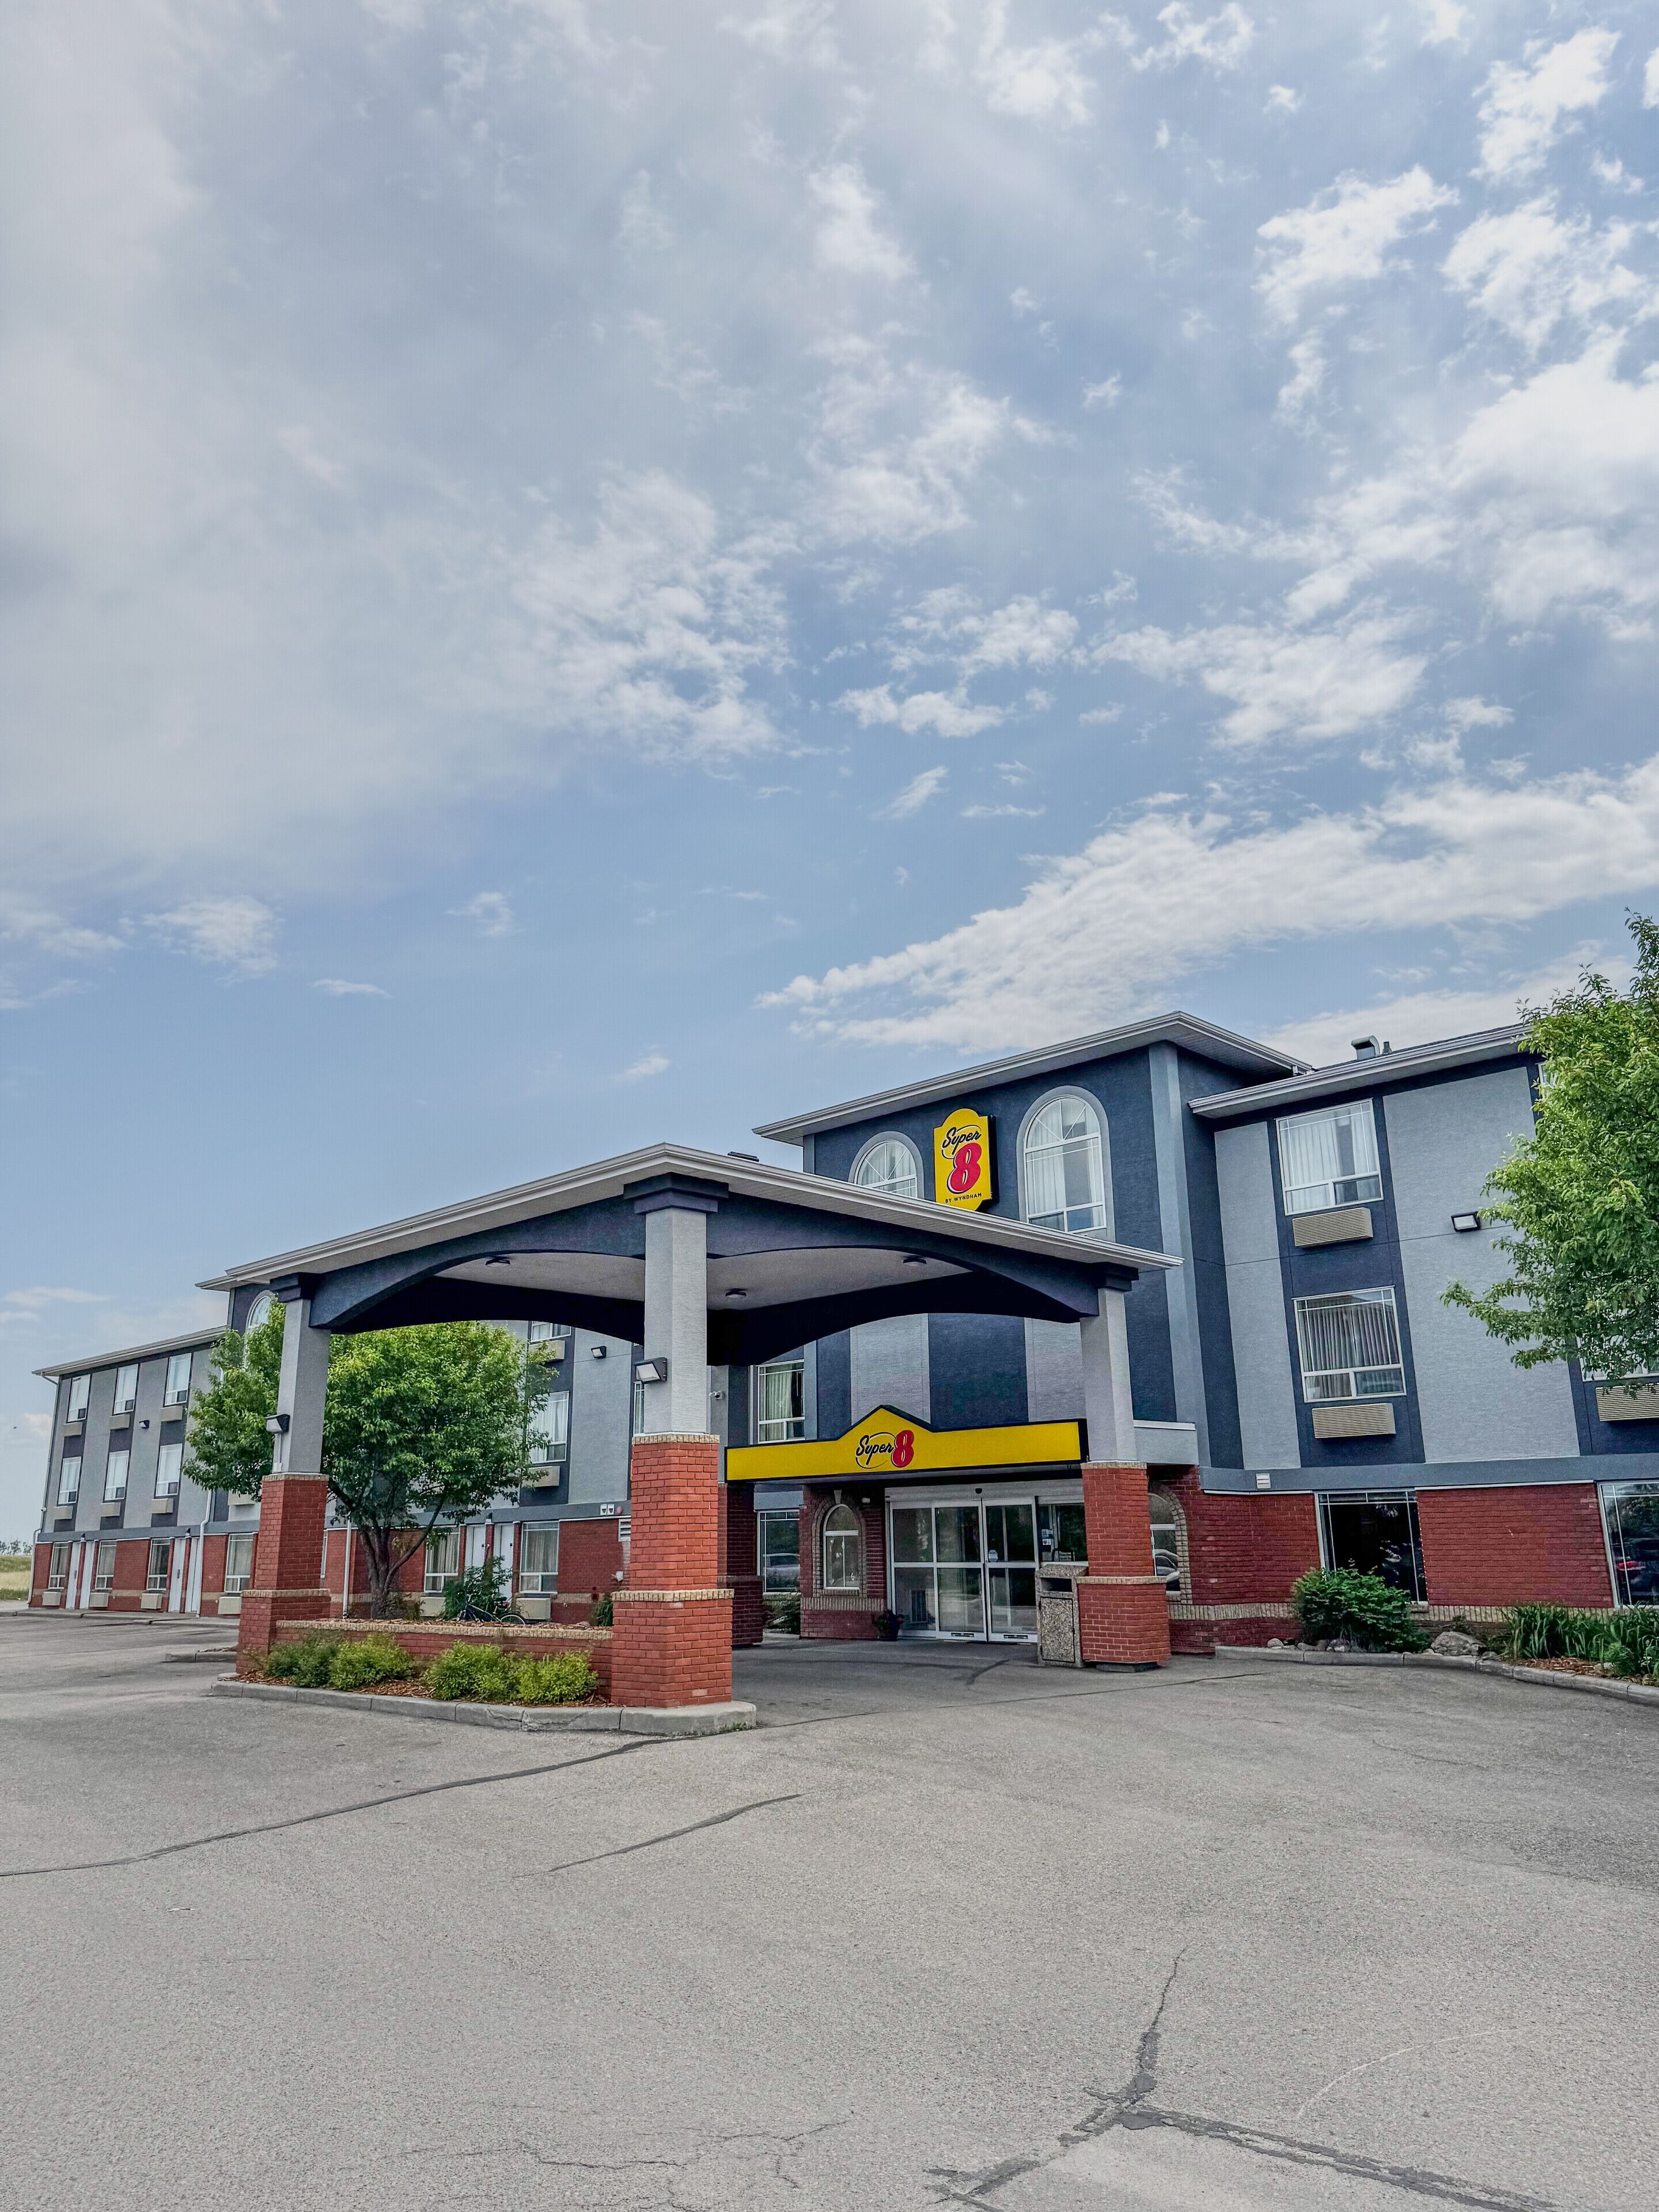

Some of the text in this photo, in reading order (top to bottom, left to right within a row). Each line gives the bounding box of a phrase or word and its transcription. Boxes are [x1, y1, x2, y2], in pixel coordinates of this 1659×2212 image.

[942, 1127, 982, 1155] Super
[946, 1142, 982, 1194] 8
[954, 1192, 982, 1202] WYNDHAM
[856, 1430, 914, 1468] Super 8
